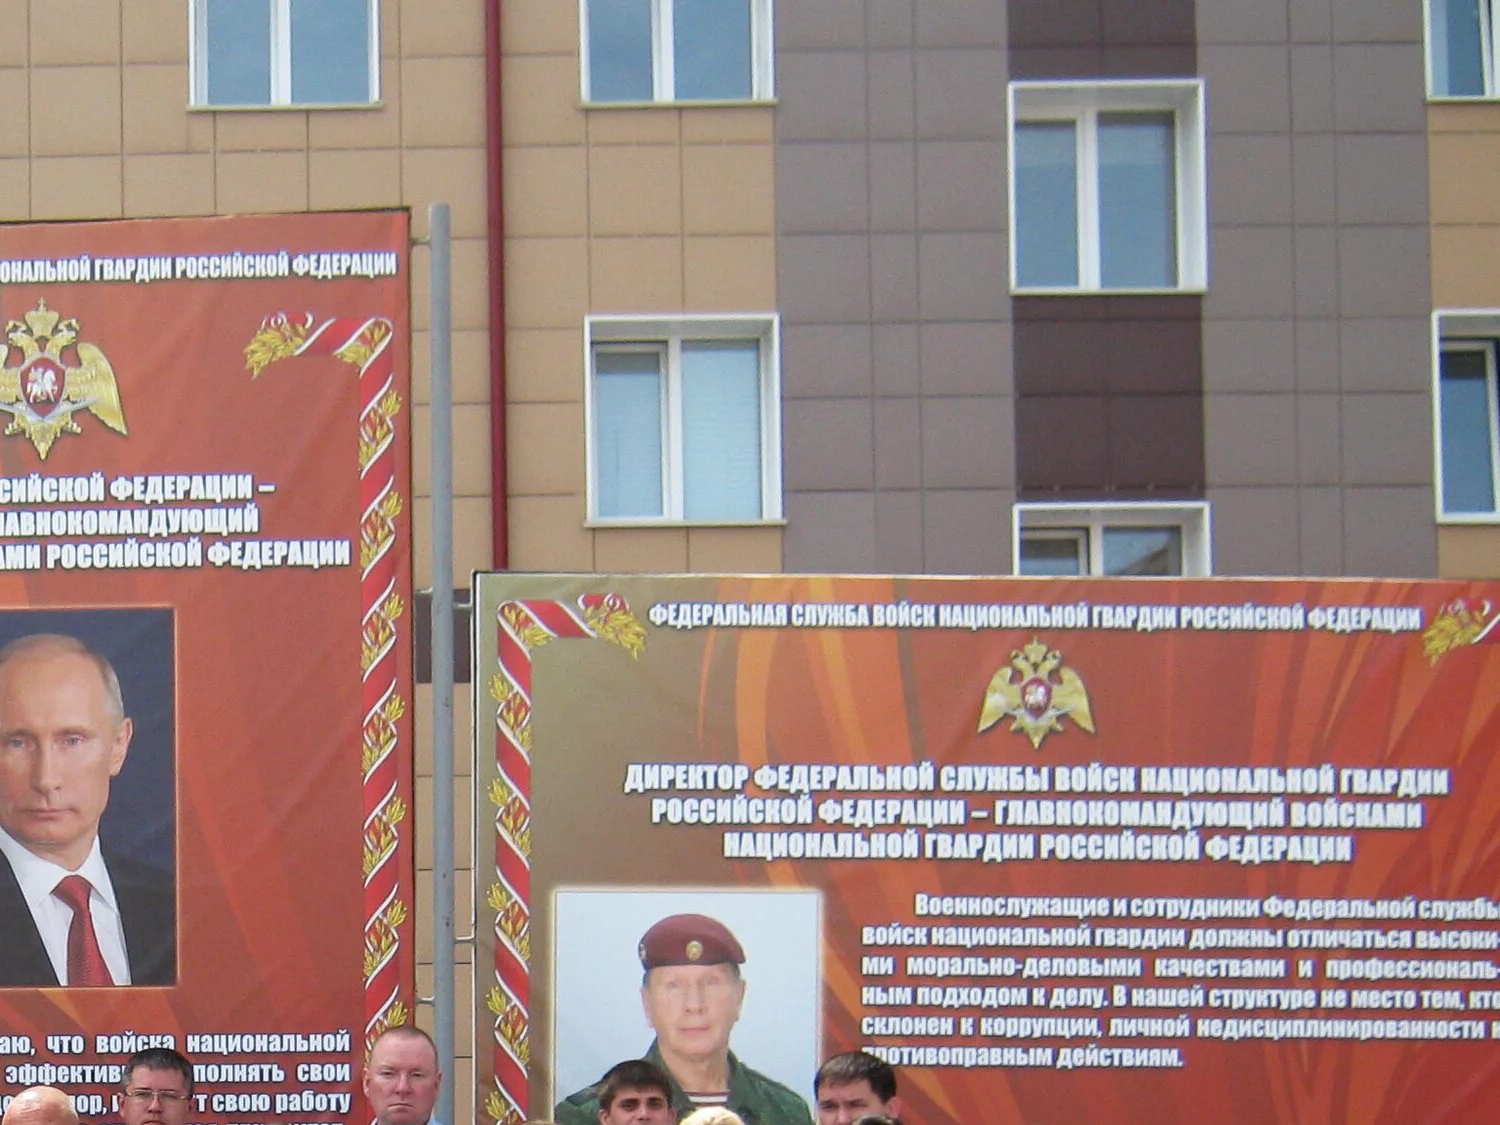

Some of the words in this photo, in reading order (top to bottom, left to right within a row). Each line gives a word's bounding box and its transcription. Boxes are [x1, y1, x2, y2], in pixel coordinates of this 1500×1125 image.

[94, 256, 172, 284] ГВАРДИИ
[175, 251, 290, 279] РОССИЙСКОЙ
[291, 251, 397, 280] ФЕДЕРАЦИИ
[109, 473, 256, 511] ФЕДЕРАЦИИ
[46, 537, 202, 569] РОССИЙСКОЙ
[207, 539, 350, 570] ФЕДЕРАЦИИ
[649, 599, 788, 630] ФЕДЕРАЛЬНАЯ
[791, 601, 870, 627] СЛУЖБА
[872, 600, 936, 627] ВОЙСК
[938, 601, 1089, 631] НАЦИОНАЛЬНОЙ
[1092, 605, 1177, 632] ГВАРДИИ
[1180, 602, 1305, 630] РОССИЙСКОЙ
[1307, 606, 1421, 633] ФЕДЕРАЦИИ
[624, 763, 749, 798] ДИРЕКТОР
[753, 760, 935, 799] ФЕДЕРАЛЬНОЙ
[940, 765, 1050, 792] СЛУЖБЫ
[1054, 761, 1136, 793] ВОЙСК
[1141, 763, 1336, 801] НАЦИОНАЛЬНОЙ
[1340, 768, 1448, 798] ГВАРДИИ
[651, 793, 813, 824] РОССИЙСКОЙ
[818, 798, 965, 831] ФЕДЕРАЦИИ
[994, 796, 1285, 832] ГЛАВНОКОМАНДУЮЩИЙ
[1290, 797, 1422, 828] ВОЙСКАМИ
[723, 828, 919, 862] НАЦИОНАЛЬНОЙ
[924, 832, 1034, 863] ГВАРДИИ
[1040, 829, 1200, 861] РОССИЙСКОЙ
[1204, 834, 1352, 865] ФЕДЕРАЦИИ
[915, 893, 1110, 920] Военнослужащие
[1113, 898, 1127, 917] и
[1130, 897, 1260, 920] сотрудники
[1262, 895, 1416, 921] Федеральной
[862, 922, 928, 946] войск
[931, 923, 1091, 949] национальной
[1094, 927, 1186, 950] гвардии
[1188, 928, 1283, 950] должны
[1286, 929, 1412, 949] отличаться
[862, 956, 894, 975] ми
[907, 956, 1141, 979] морально-деловыми
[1154, 957, 1285, 978] качествами
[1298, 959, 1313, 978] и
[862, 986, 913, 1005] ным
[916, 986, 1028, 1009] подходом
[1032, 987, 1046, 1006] к
[1049, 987, 1109, 1009] делу.
[1113, 984, 1127, 1007] В
[1131, 984, 1204, 1007] нашей
[1208, 988, 1316, 1010] структуре
[1320, 989, 1347, 1008] не
[1351, 989, 1417, 1009] место
[1420, 990, 1465, 1010] тем,
[861, 1016, 954, 1036] склонен
[960, 1017, 974, 1036] к
[980, 1016, 1103, 1040] коррупции,
[1108, 1014, 1190, 1037] личной
[1197, 1018, 1485, 1041] недисциплинированности
[46, 1034, 86, 1054] что
[95, 1029, 176, 1054] войска
[186, 1029, 351, 1056] национальной
[1056, 1043, 1184, 1069] действиям.
[4, 1062, 129, 1087] эффектив
[192, 1062, 286, 1084] полнять
[296, 1062, 351, 1083] свои
[211, 1093, 271, 1114] свою
[274, 1089, 352, 1115] работу
